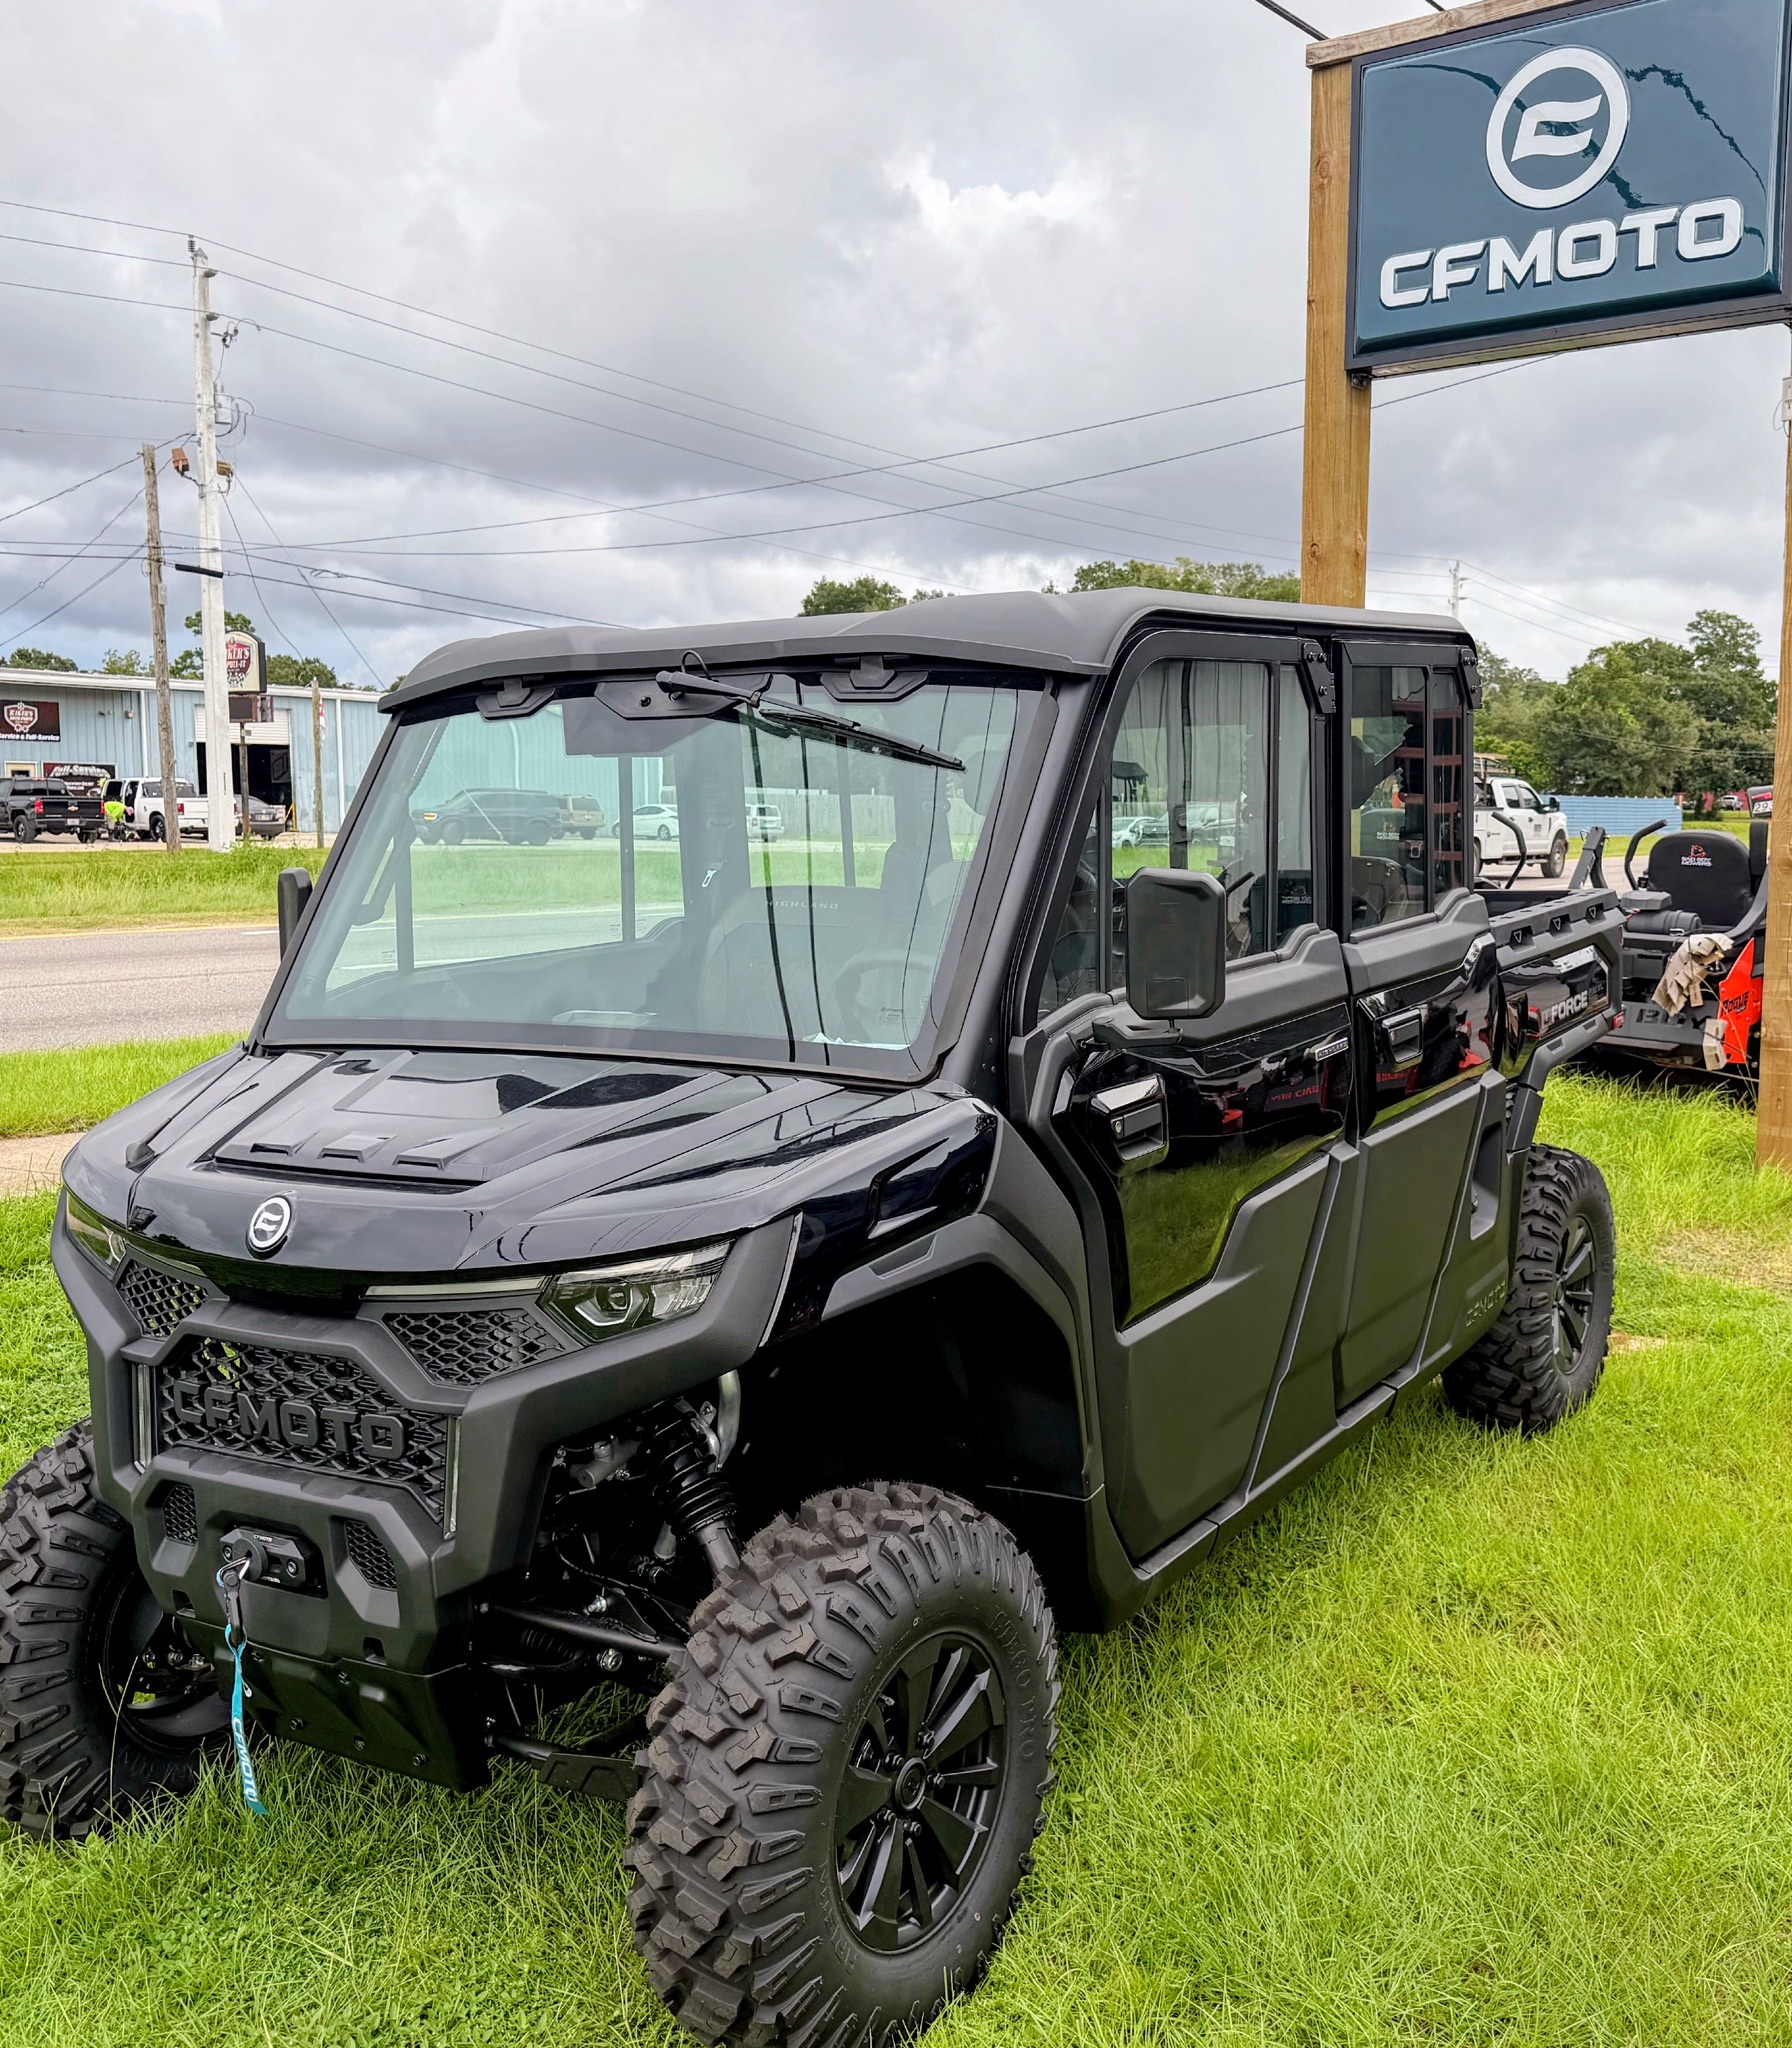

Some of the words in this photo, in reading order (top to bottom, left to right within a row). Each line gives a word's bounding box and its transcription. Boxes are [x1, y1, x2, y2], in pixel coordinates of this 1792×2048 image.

[1380, 195, 1744, 309] CFMOTO
[225, 647, 250, 660] IKER'S
[49, 764, 111, 779] Full-Service
[766, 900, 839, 910] HIGHLAND
[173, 1378, 405, 1459] CFMOTO
[231, 1716, 258, 1803] CFMOTO
